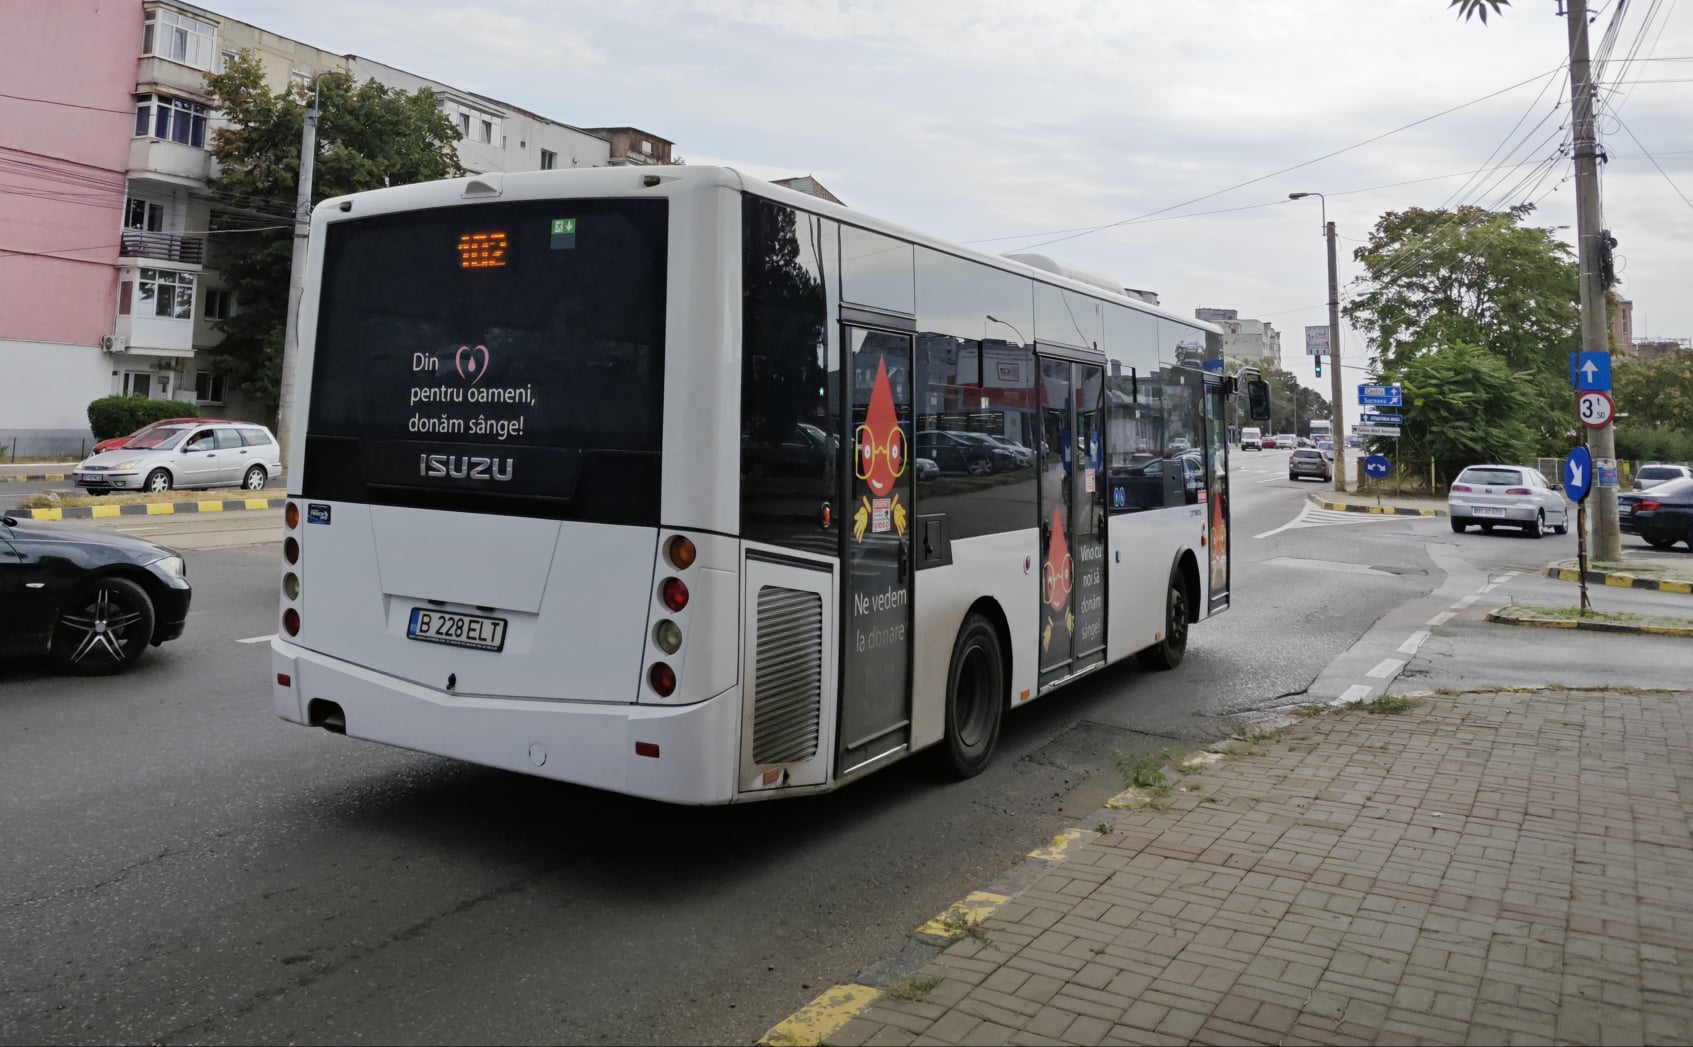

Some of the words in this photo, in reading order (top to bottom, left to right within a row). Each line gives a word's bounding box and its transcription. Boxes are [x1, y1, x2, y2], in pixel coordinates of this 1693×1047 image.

[412, 352, 439, 371] Din
[410, 384, 463, 406] pentru
[467, 384, 536, 406] oameni,
[1582, 398, 1594, 419] 3
[408, 412, 464, 434] donăm
[469, 414, 525, 440] sânge!
[420, 454, 514, 482] ISUZU
[1080, 545, 1094, 562] Vino
[1095, 545, 1102, 559] cu
[854, 592, 870, 617] Ne
[871, 585, 907, 613] vedem
[419, 613, 432, 634] B
[435, 615, 465, 639] 228
[466, 619, 501, 643] ELT
[856, 628, 865, 654] la
[867, 623, 905, 650] donare
